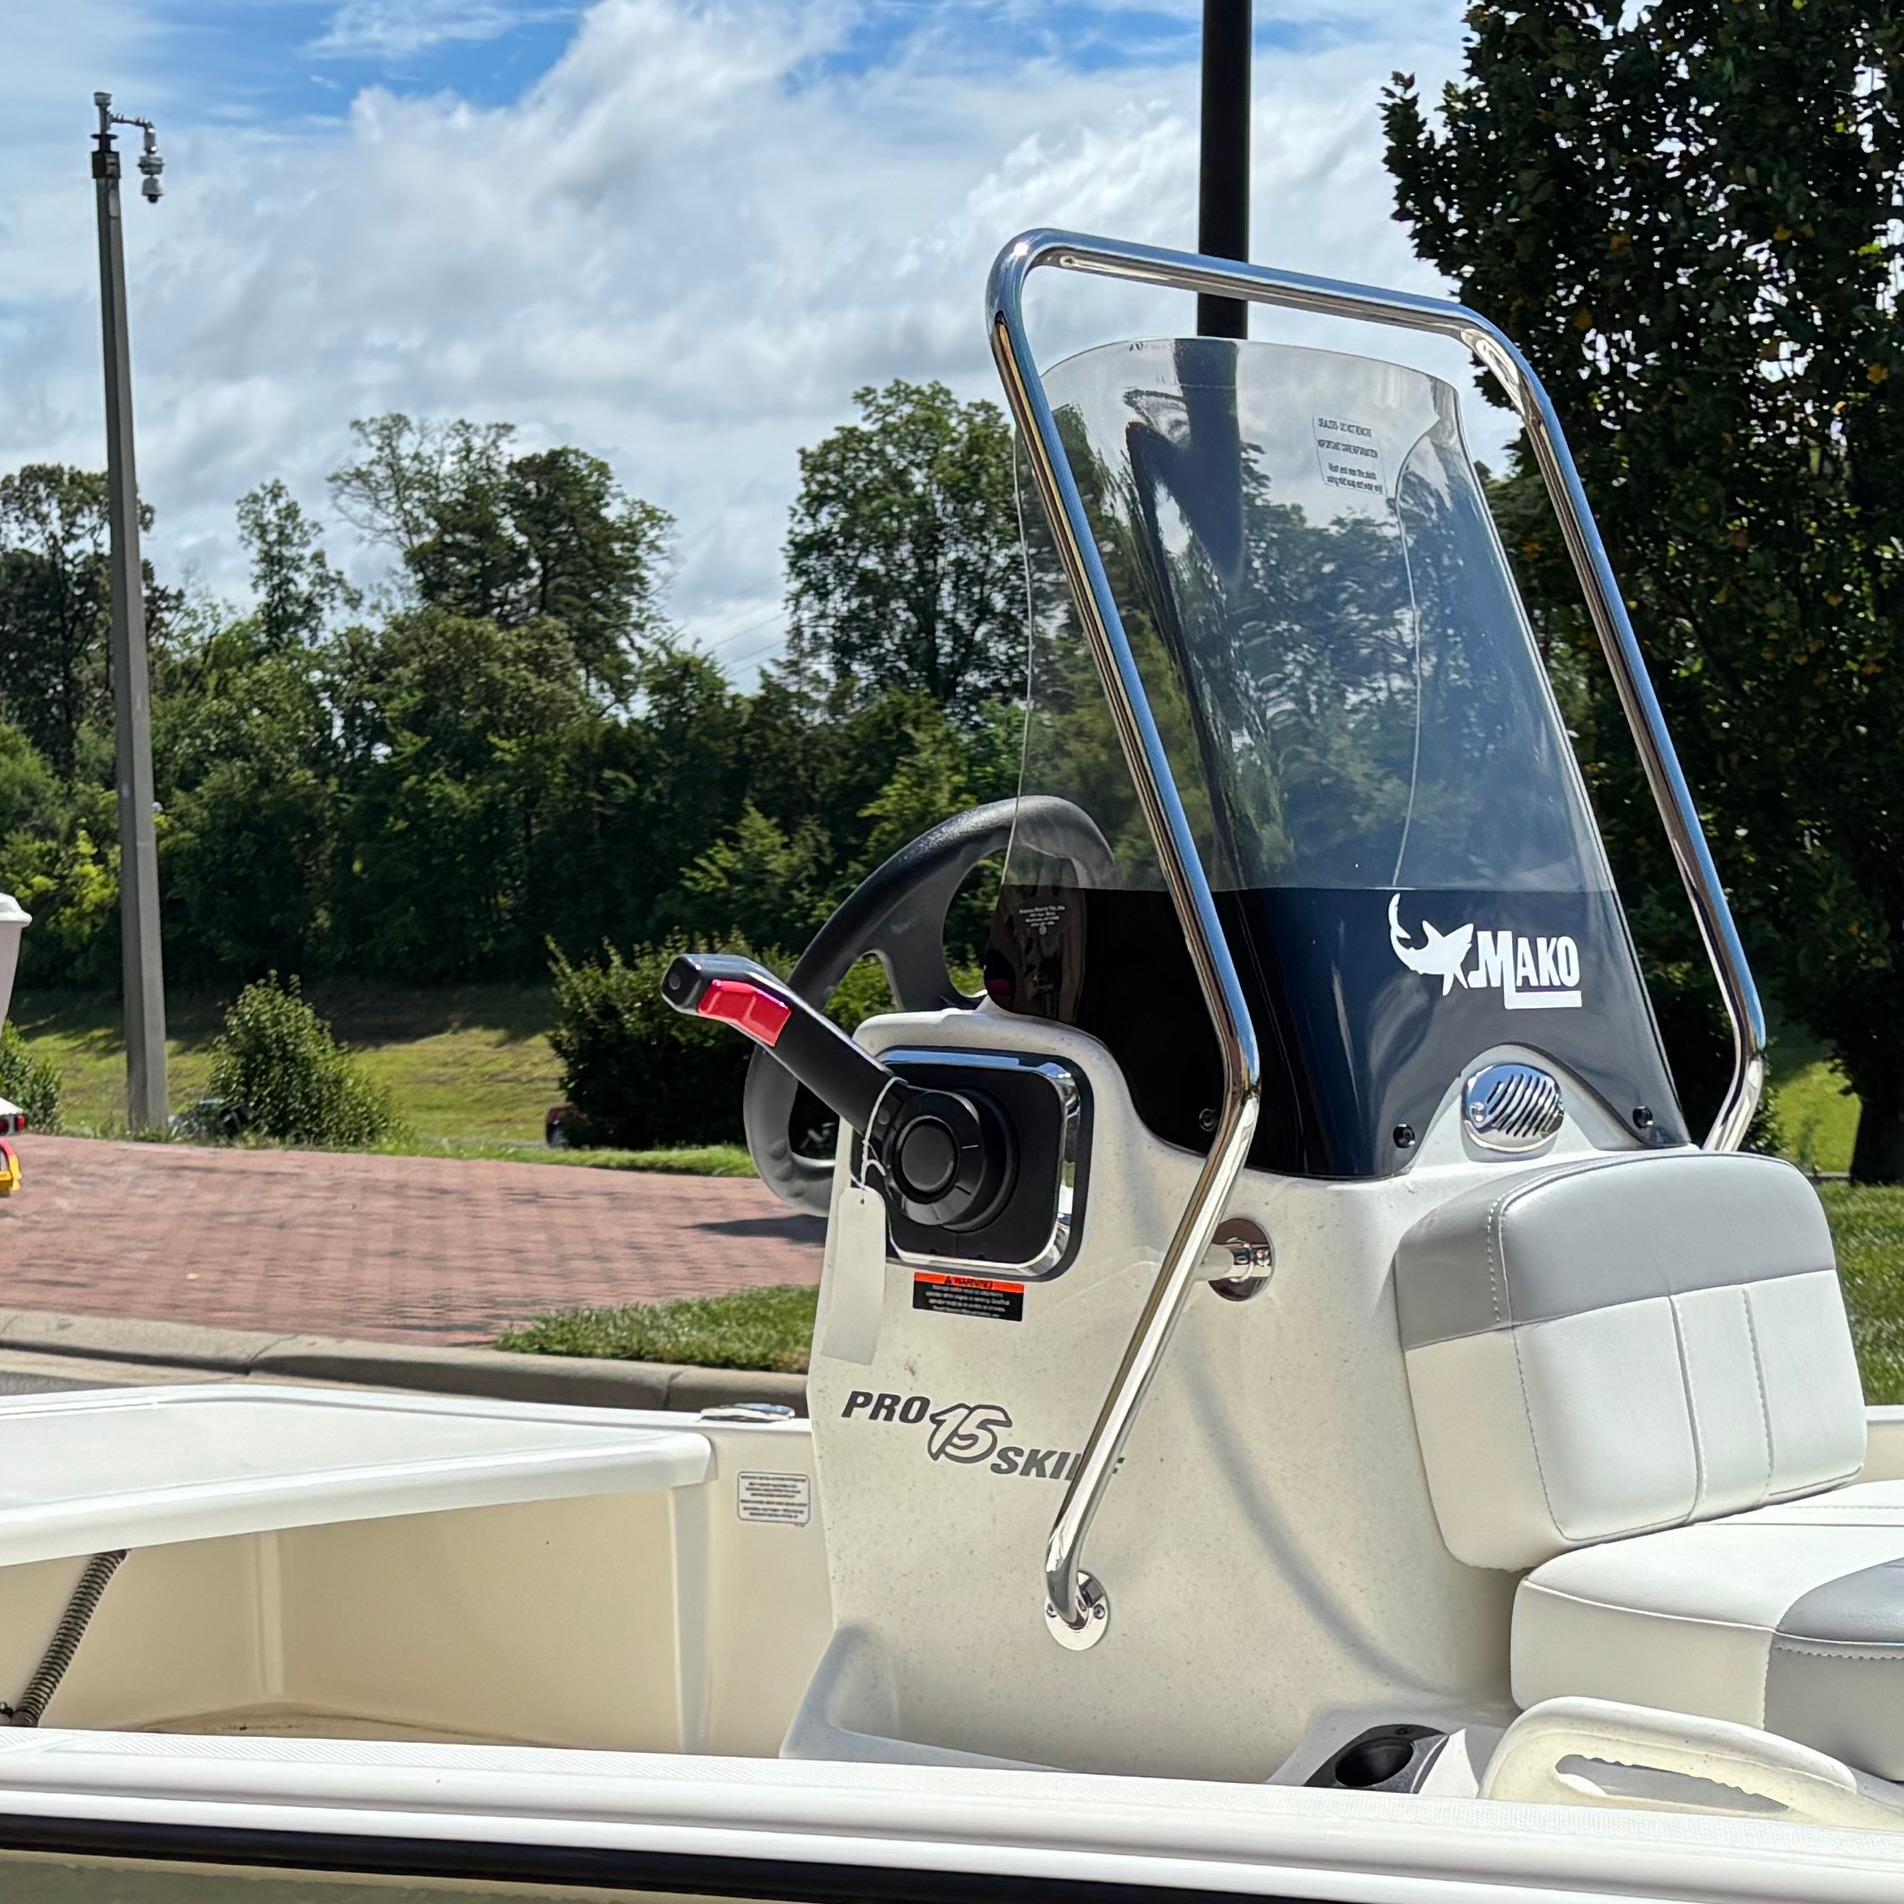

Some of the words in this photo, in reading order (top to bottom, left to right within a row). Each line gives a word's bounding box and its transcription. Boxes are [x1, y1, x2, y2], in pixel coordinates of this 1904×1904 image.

[1466, 930, 1583, 1010] MAKO
[840, 1390, 931, 1425] PRO
[926, 1402, 1013, 1465] 15
